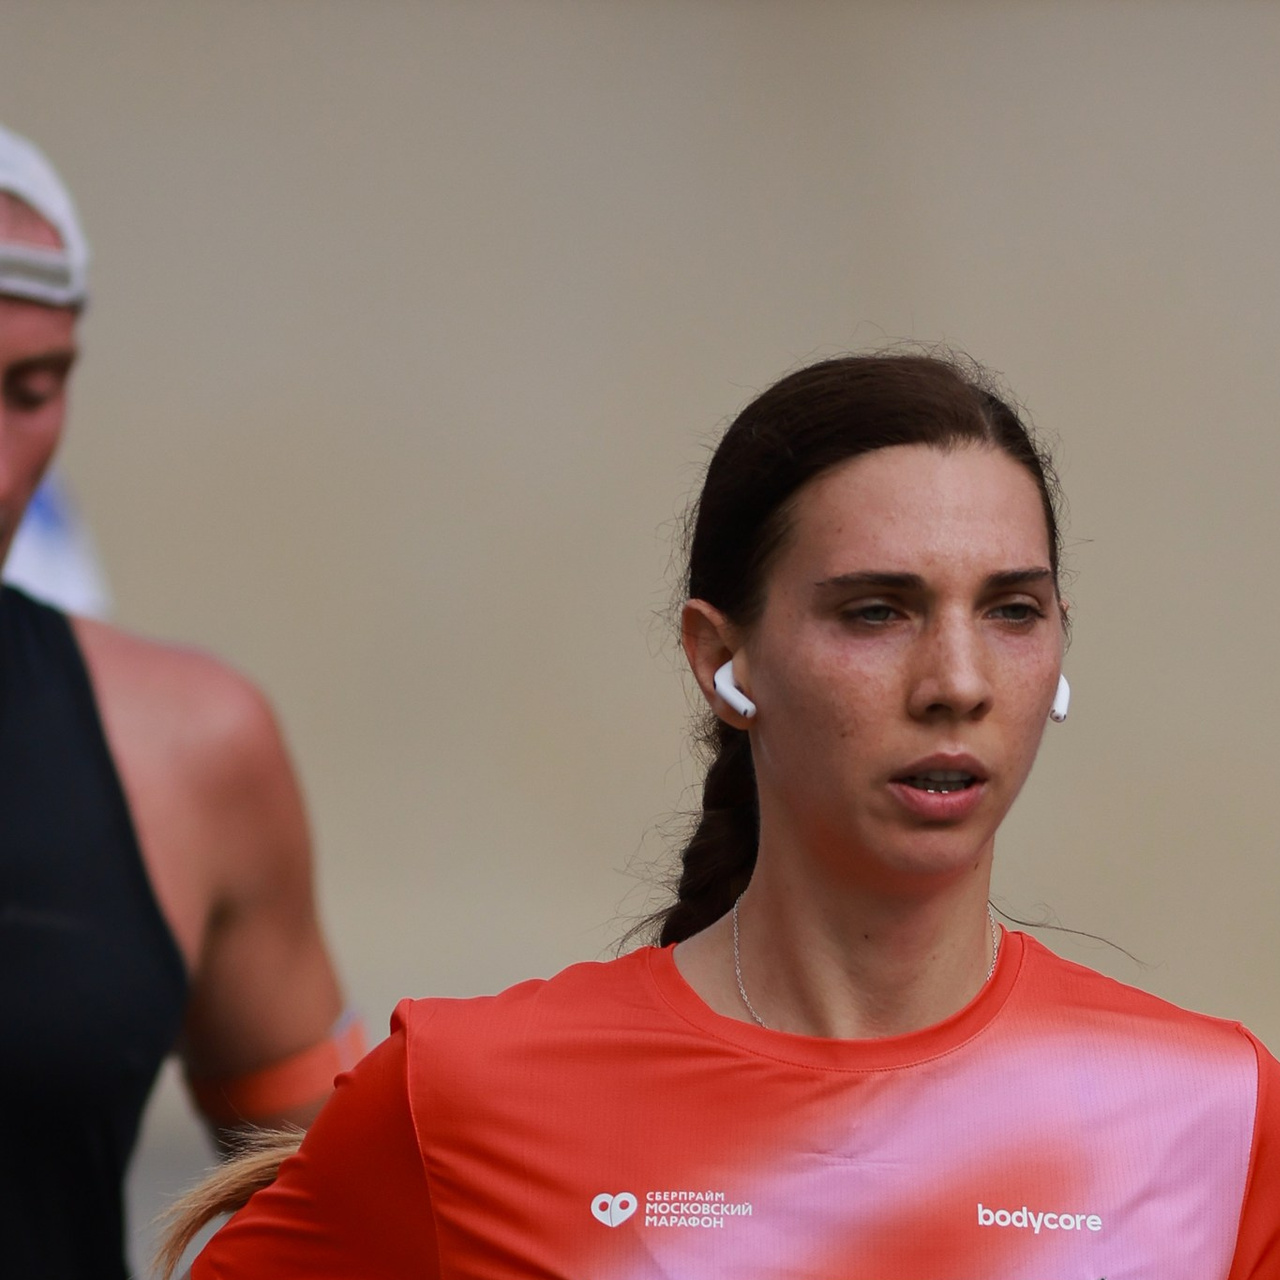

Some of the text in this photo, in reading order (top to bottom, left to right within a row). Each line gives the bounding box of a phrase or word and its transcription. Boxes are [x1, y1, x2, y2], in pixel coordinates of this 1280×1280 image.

[646, 1190, 725, 1201] СБЕРПРАЙМ
[645, 1202, 753, 1216] МОСКОВСКИЙ
[645, 1216, 724, 1228] МАРАФОН
[977, 1203, 1102, 1234] bodycore
